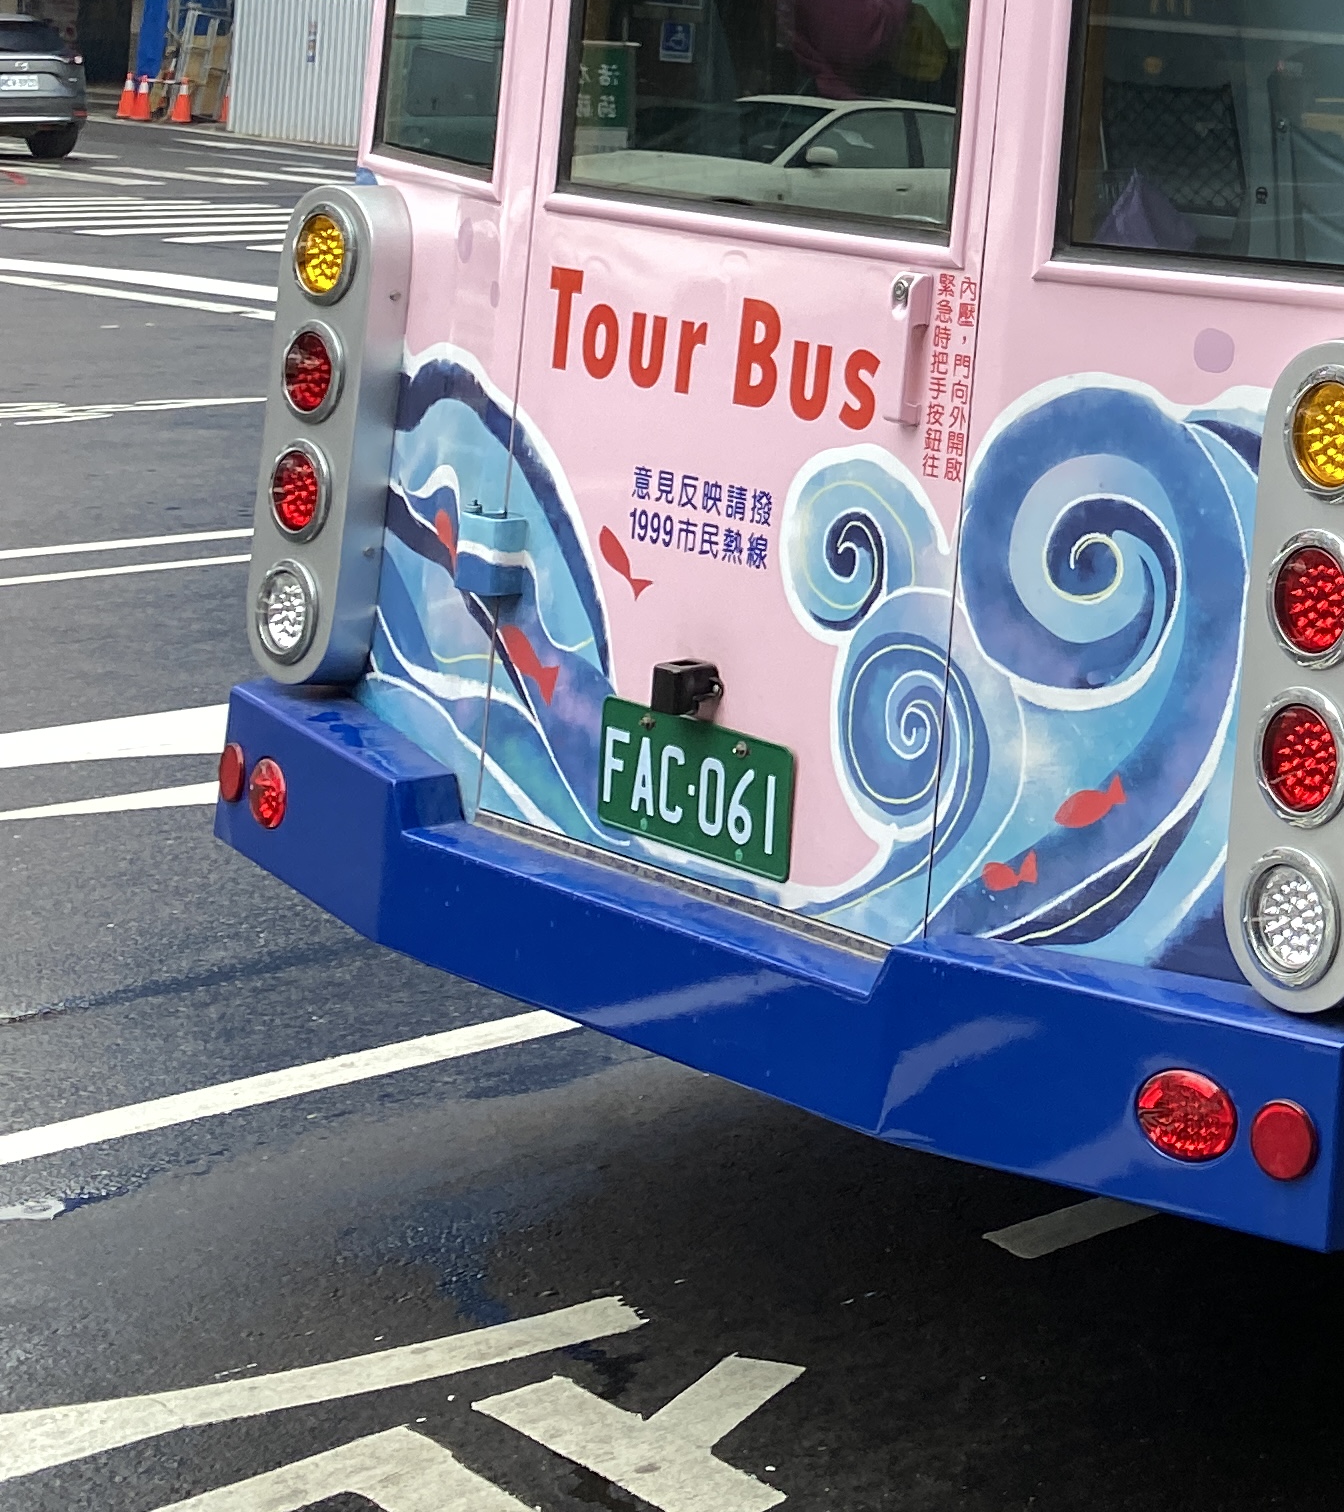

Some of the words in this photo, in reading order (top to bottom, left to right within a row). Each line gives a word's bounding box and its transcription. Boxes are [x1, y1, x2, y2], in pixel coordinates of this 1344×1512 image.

[551, 266, 708, 396] Tour
[732, 297, 880, 430] Bus
[922, 273, 956, 478] 緊急時把手按鈕往
[629, 507, 768, 570] 1999市民熱線
[631, 466, 773, 527] 意見反映請撥
